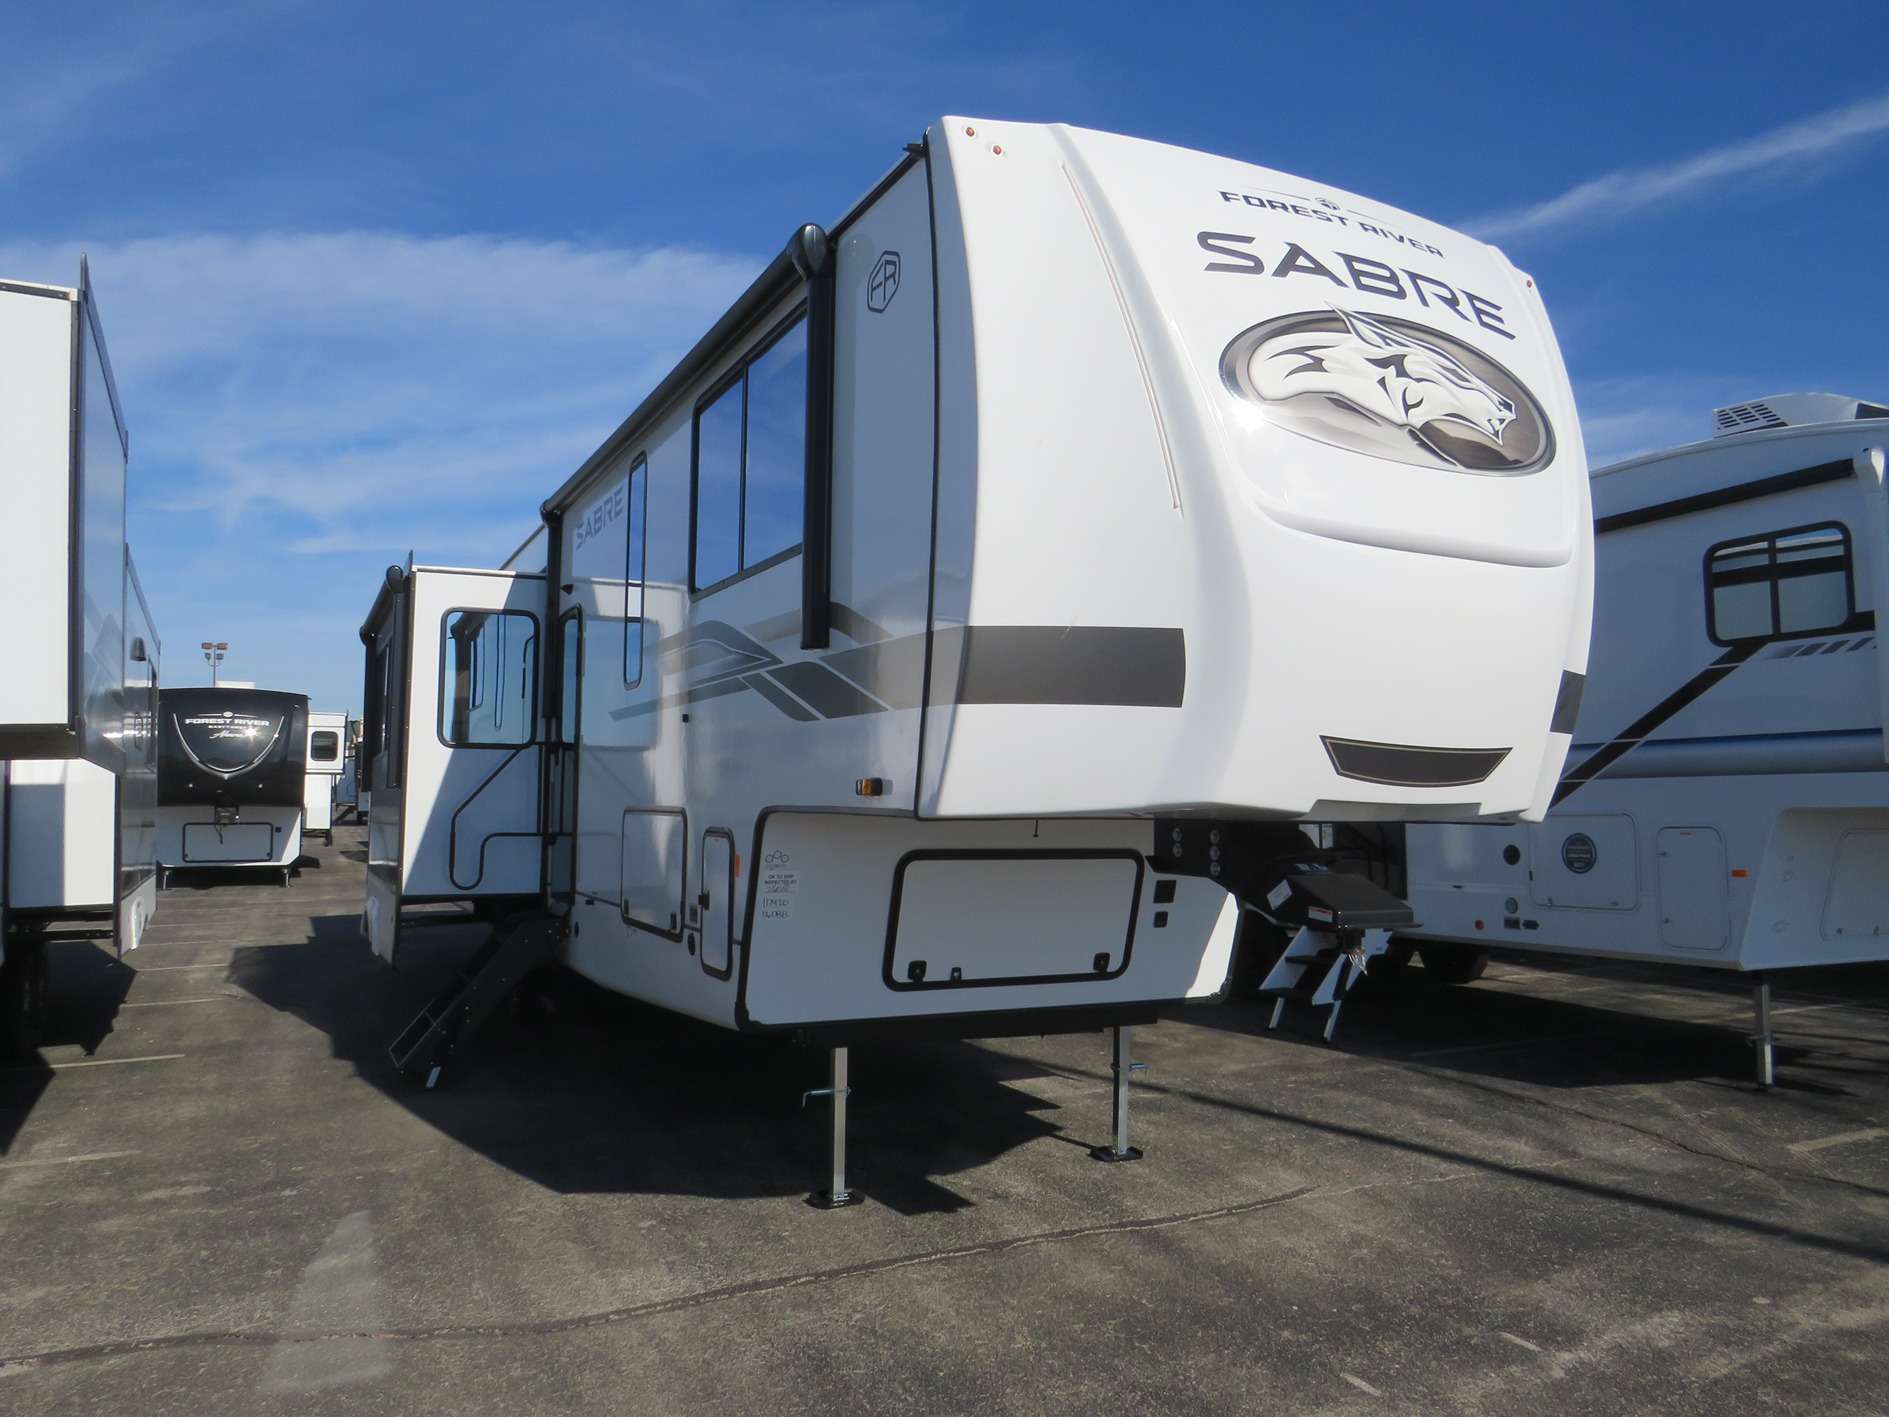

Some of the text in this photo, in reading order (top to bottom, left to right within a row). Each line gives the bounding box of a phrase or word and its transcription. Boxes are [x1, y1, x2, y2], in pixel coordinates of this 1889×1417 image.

[1218, 190, 1445, 258] FOREST RIVER
[1196, 231, 1517, 341] SABRE
[575, 485, 625, 551] SABRE
